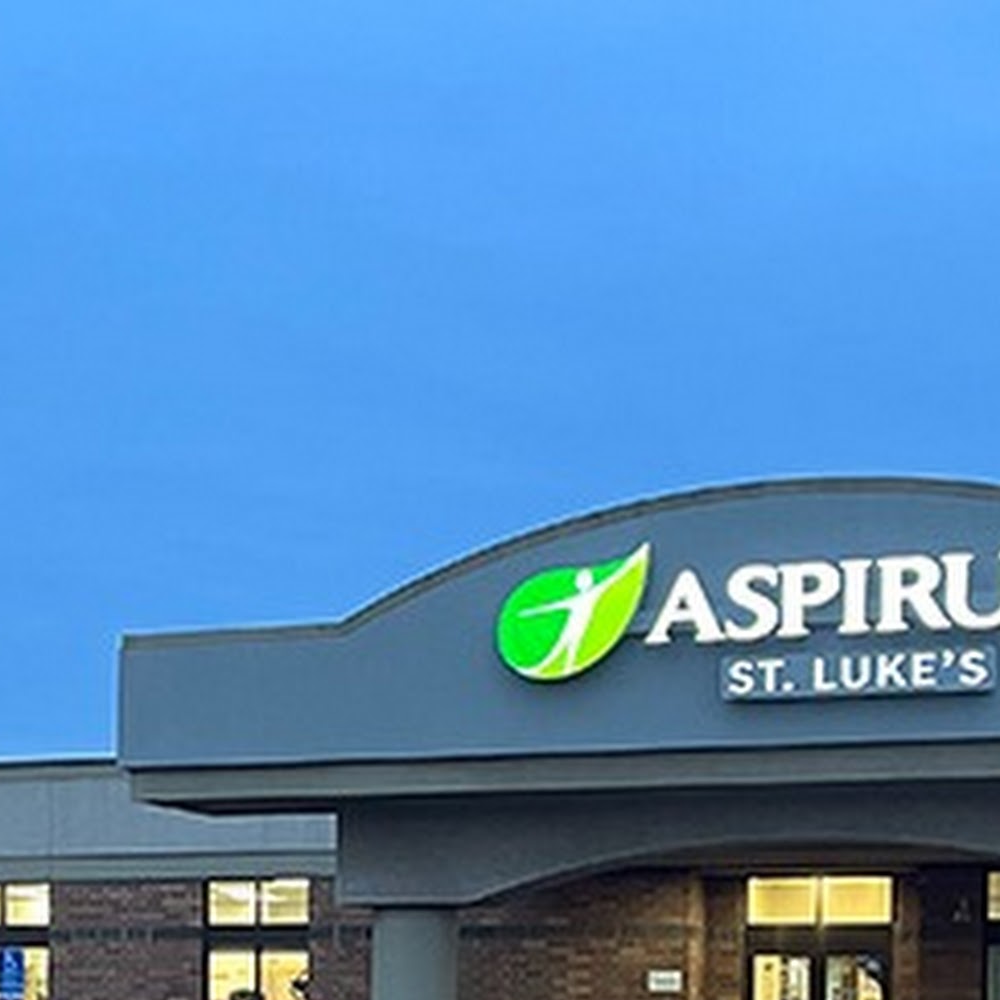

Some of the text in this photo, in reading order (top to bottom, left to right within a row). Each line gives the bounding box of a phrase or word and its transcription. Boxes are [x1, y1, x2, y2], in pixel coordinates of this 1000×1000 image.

[644, 552, 1000, 644] ASPIRU
[728, 650, 989, 694] ST. LUKE'S
